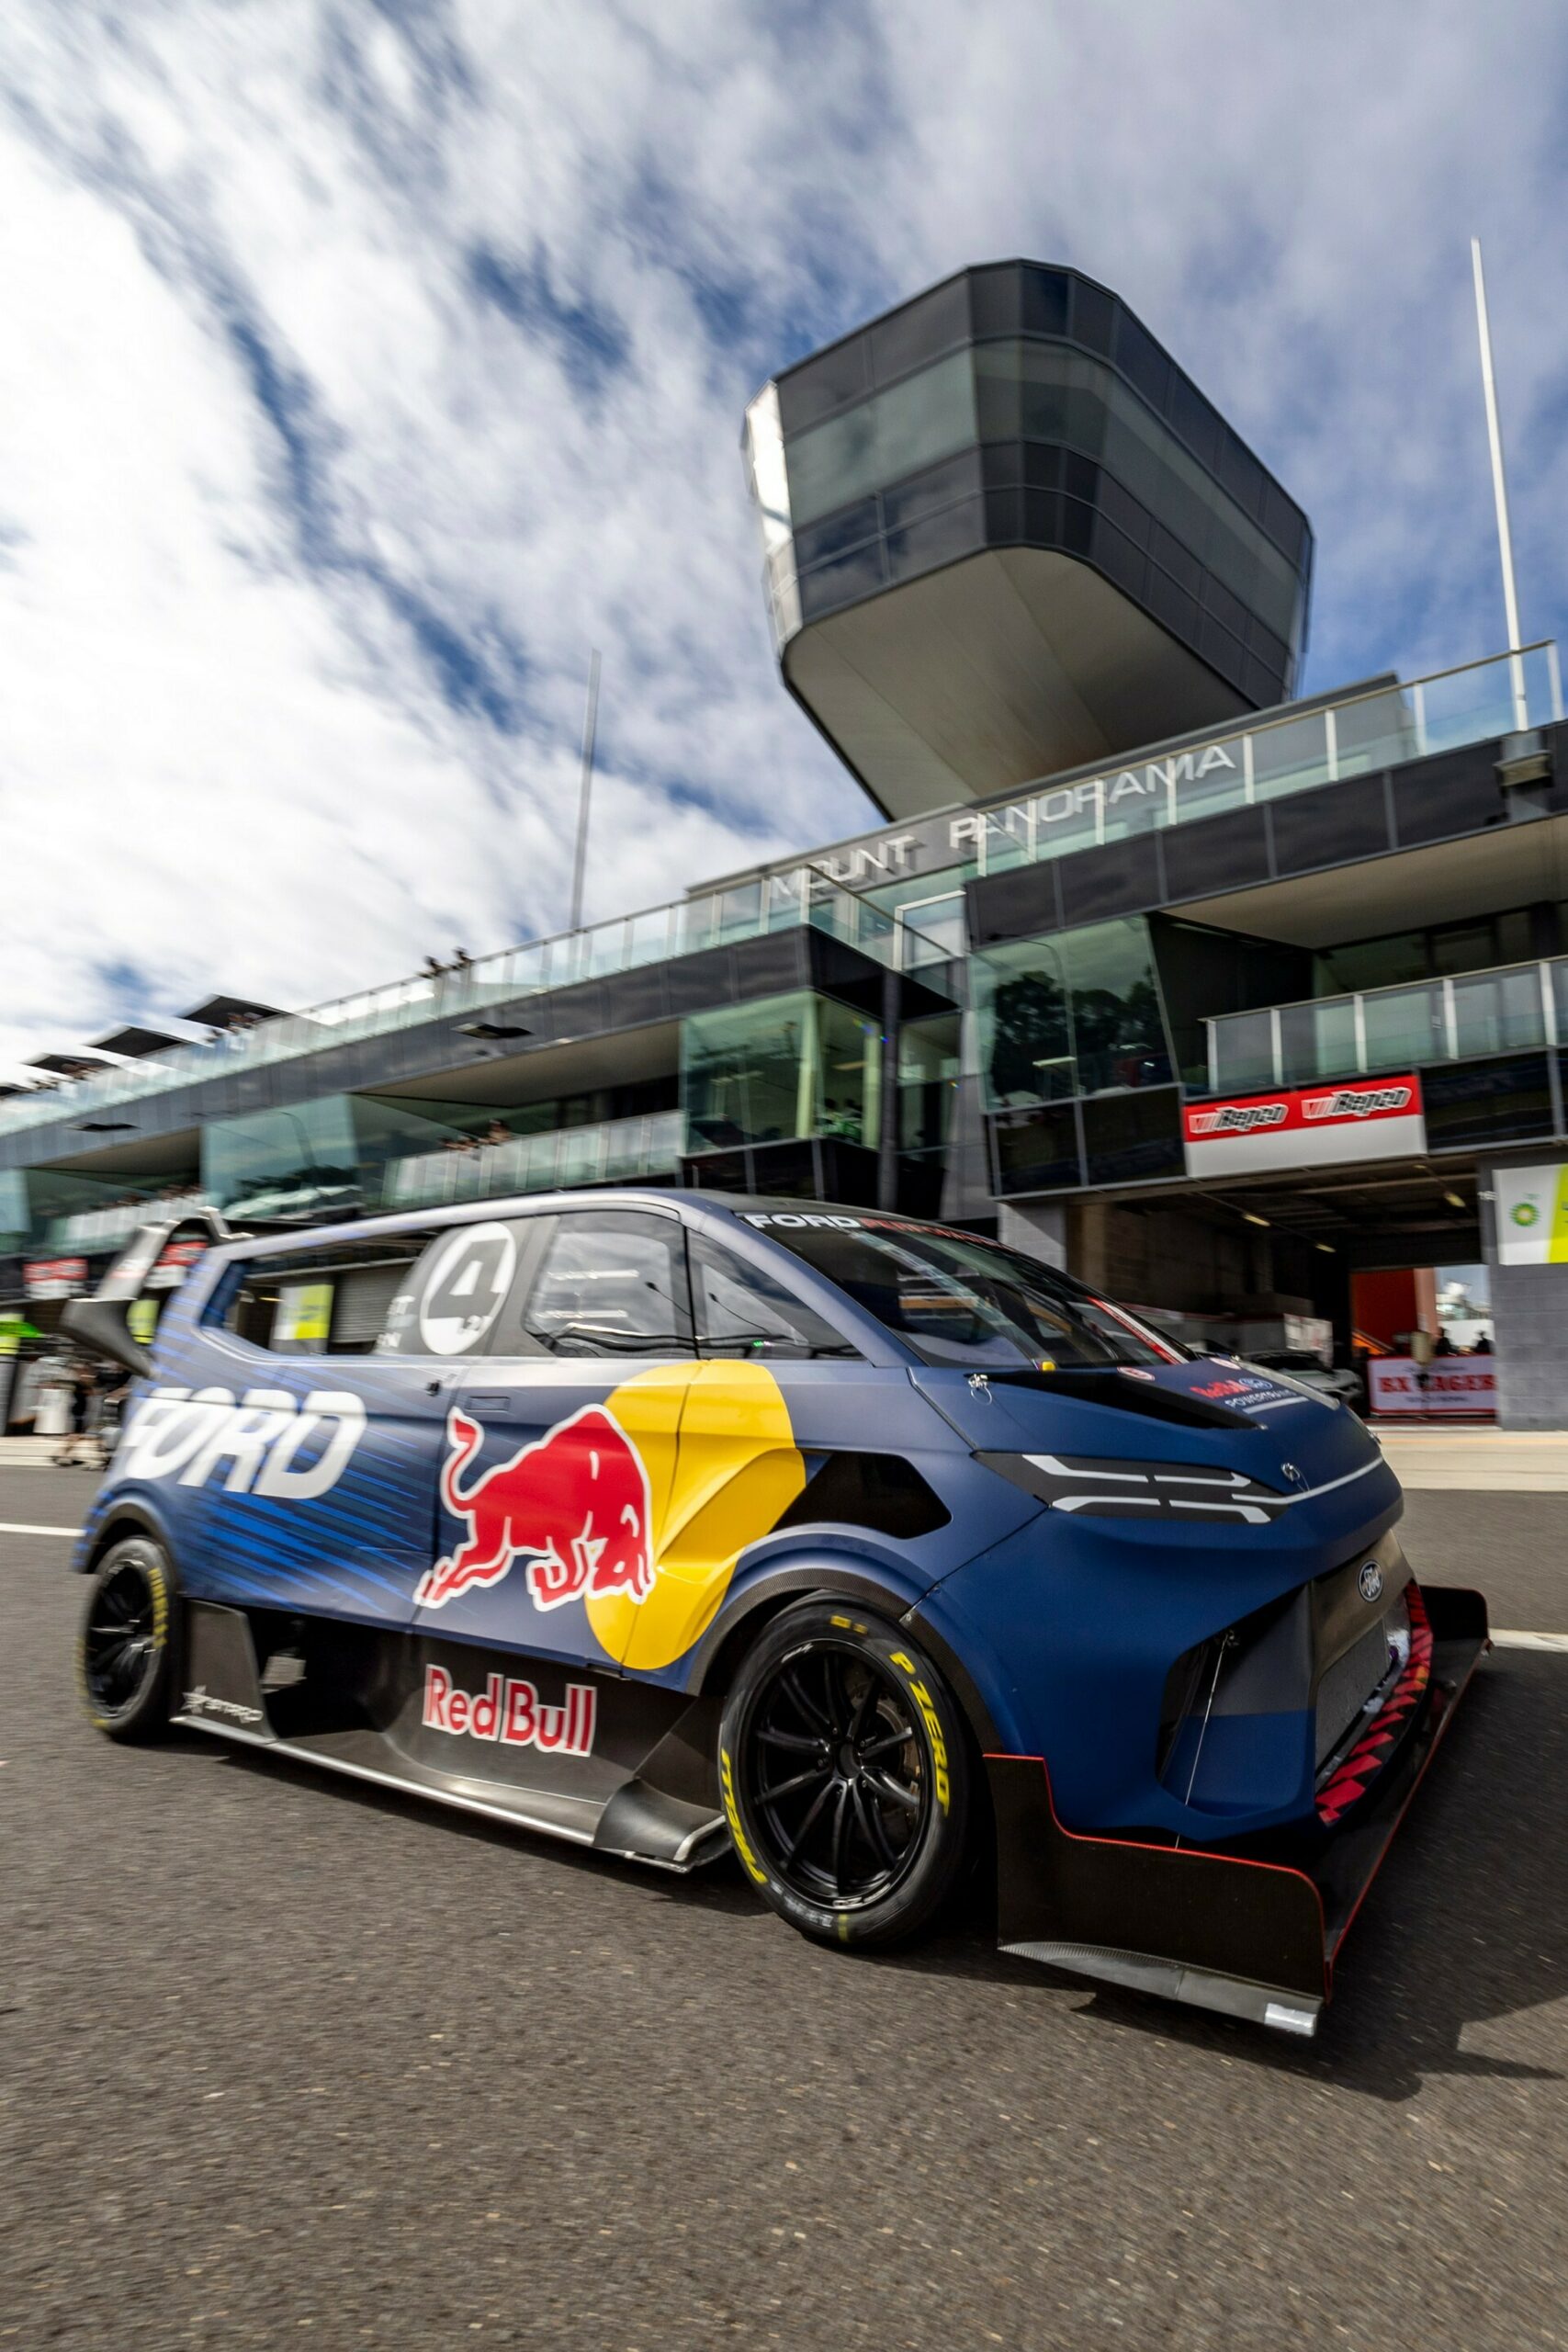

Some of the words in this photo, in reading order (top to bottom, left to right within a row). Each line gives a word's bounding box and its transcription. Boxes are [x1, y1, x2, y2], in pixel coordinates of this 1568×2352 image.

[949, 745, 1236, 849] PANORAMA
[745, 1213, 862, 1228] FORD
[118, 1386, 367, 1499] FORD
